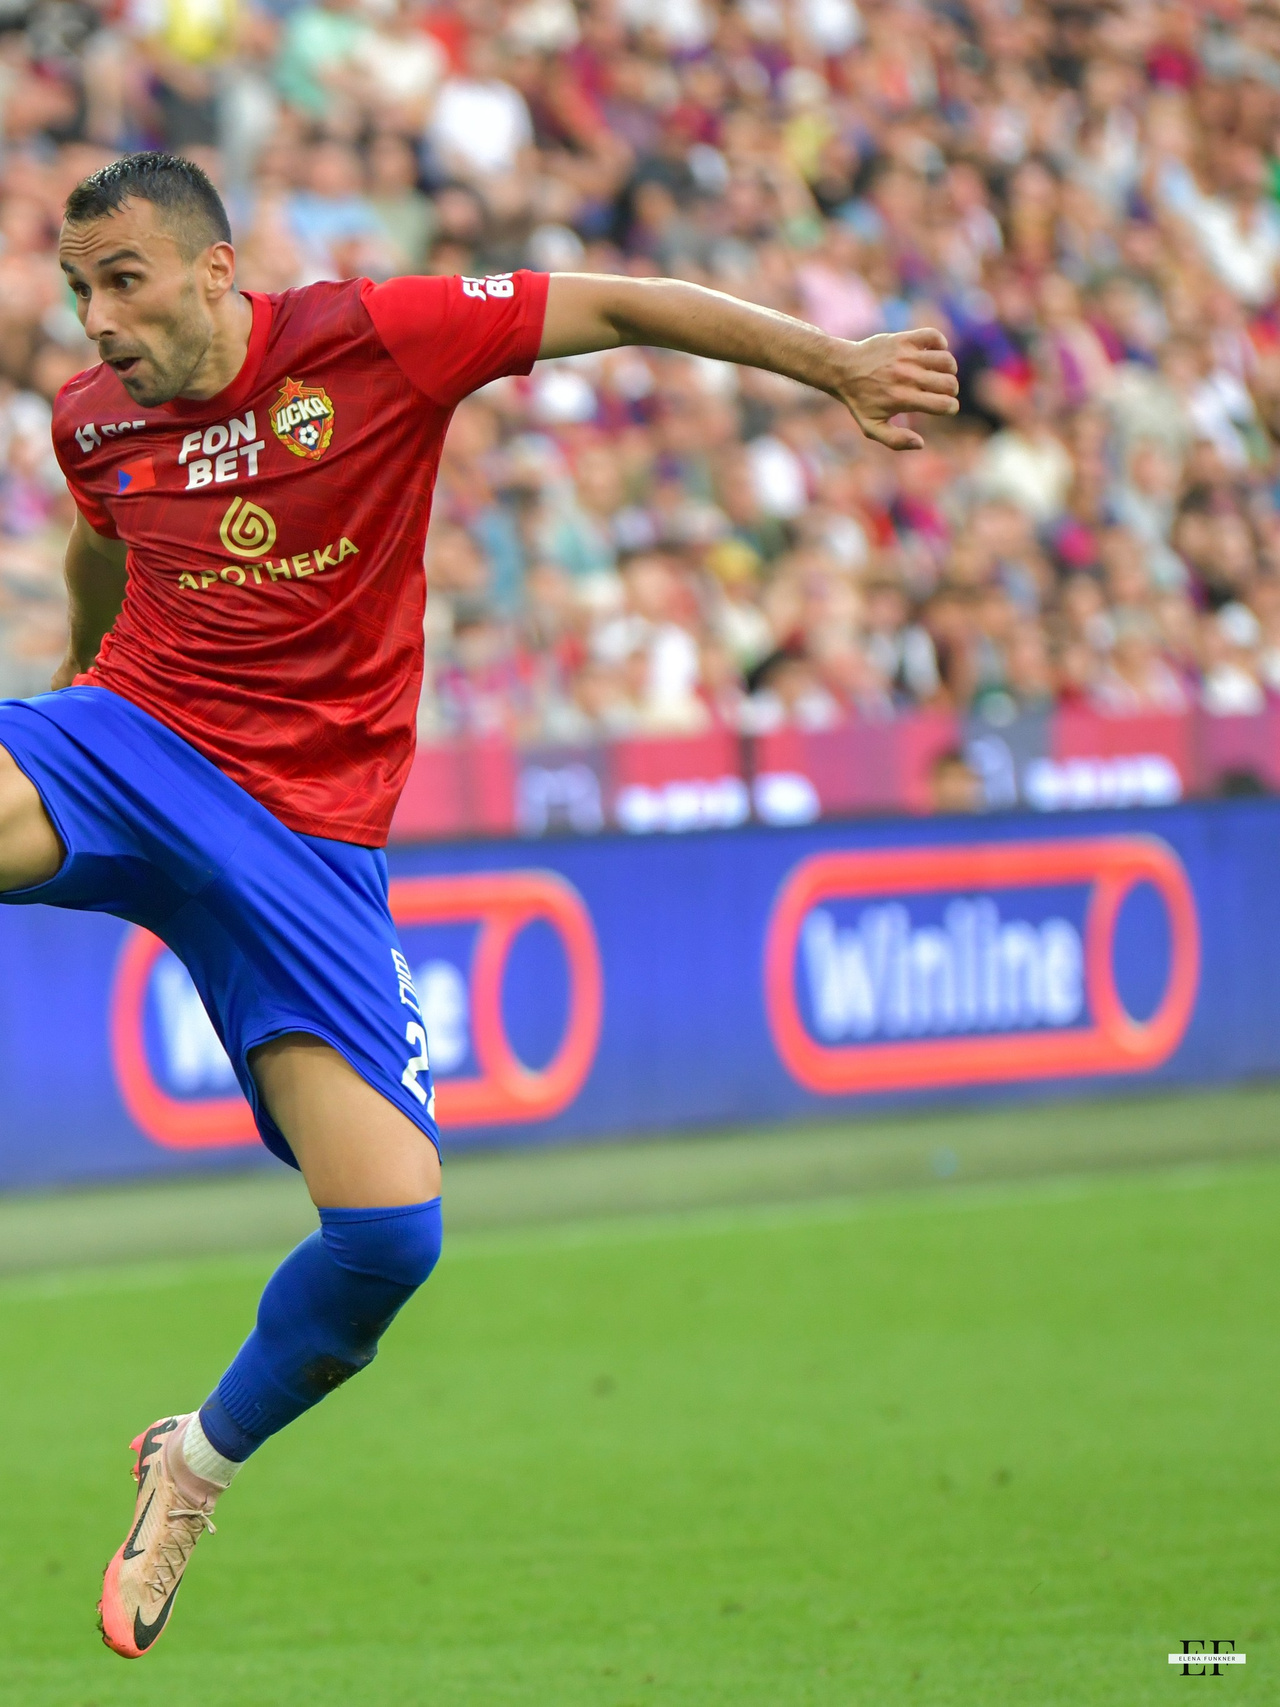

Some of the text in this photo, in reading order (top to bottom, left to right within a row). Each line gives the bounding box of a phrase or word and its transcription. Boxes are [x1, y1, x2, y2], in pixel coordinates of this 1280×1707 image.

[178, 410, 257, 465] FON
[276, 396, 331, 434] ЦСКА
[185, 440, 265, 490] BET
[178, 537, 359, 590] APOTHEKA
[804, 898, 1083, 1040] Winline
